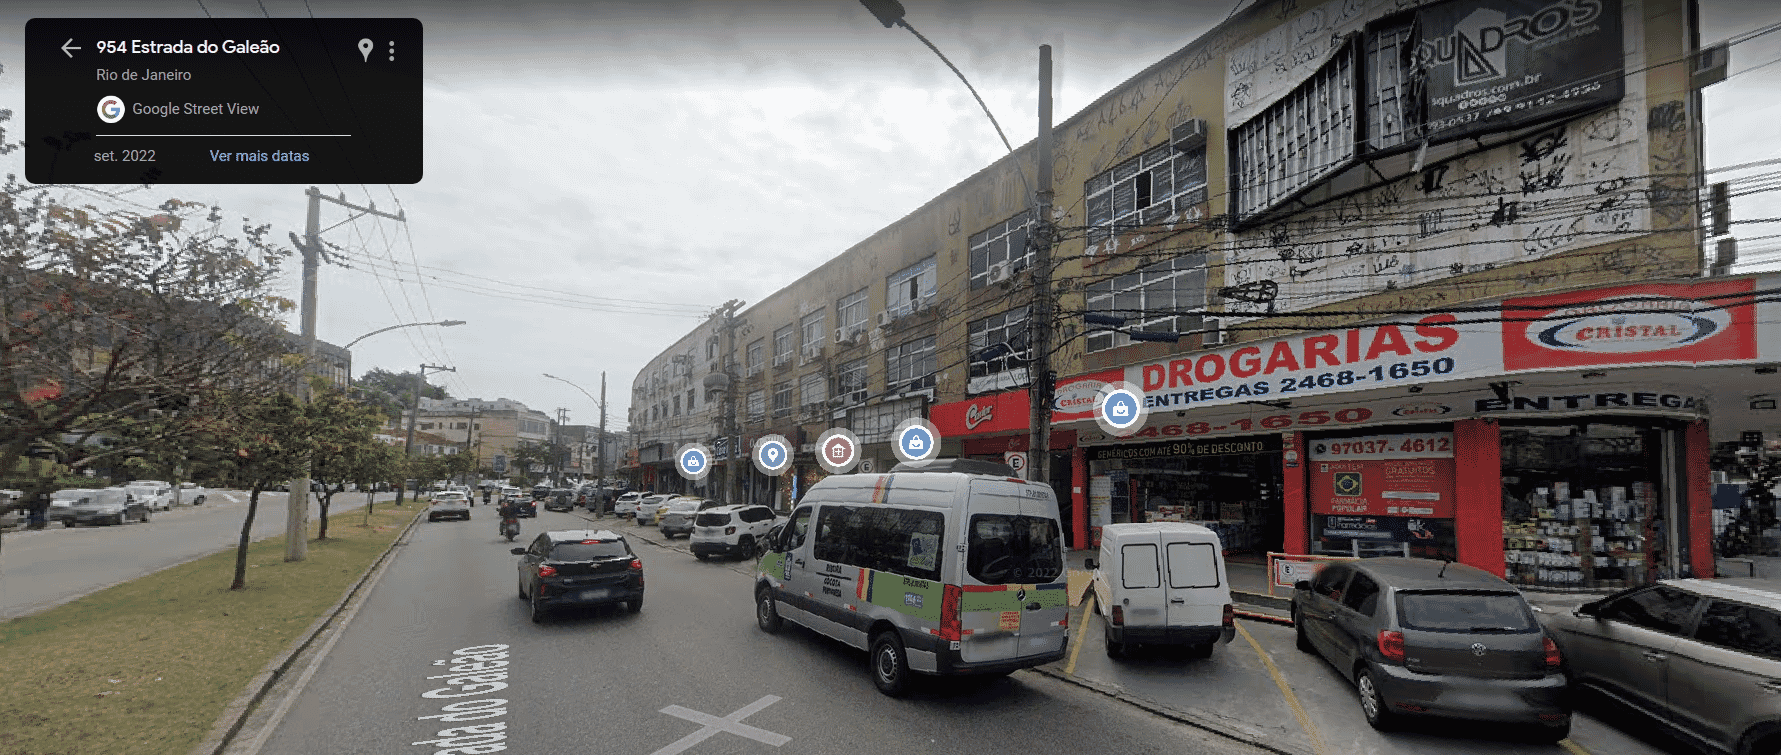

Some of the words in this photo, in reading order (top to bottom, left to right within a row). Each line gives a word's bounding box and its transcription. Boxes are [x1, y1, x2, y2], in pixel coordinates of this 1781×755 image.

[1575, 324, 1683, 342] CRISTAL
[1142, 313, 1460, 392] DROGARIAS
[1057, 381, 1102, 395] DROGARIA
[1143, 381, 1270, 409] ENTREGAS
[1280, 356, 1456, 394] 2468-1650
[1097, 446, 1138, 459] GENÉRICOS
[1139, 447, 1156, 457] COM
[1157, 444, 1172, 456] ATÉ
[1172, 442, 1195, 455] 90%
[1196, 444, 1209, 454] DE
[1211, 441, 1263, 454] DESCONTO
[1331, 439, 1395, 455] 97037-
[1400, 436, 1451, 453] 4612
[1012, 458, 1020, 468] E
[421, 643, 510, 699] Galeão
[417, 698, 508, 722] do
